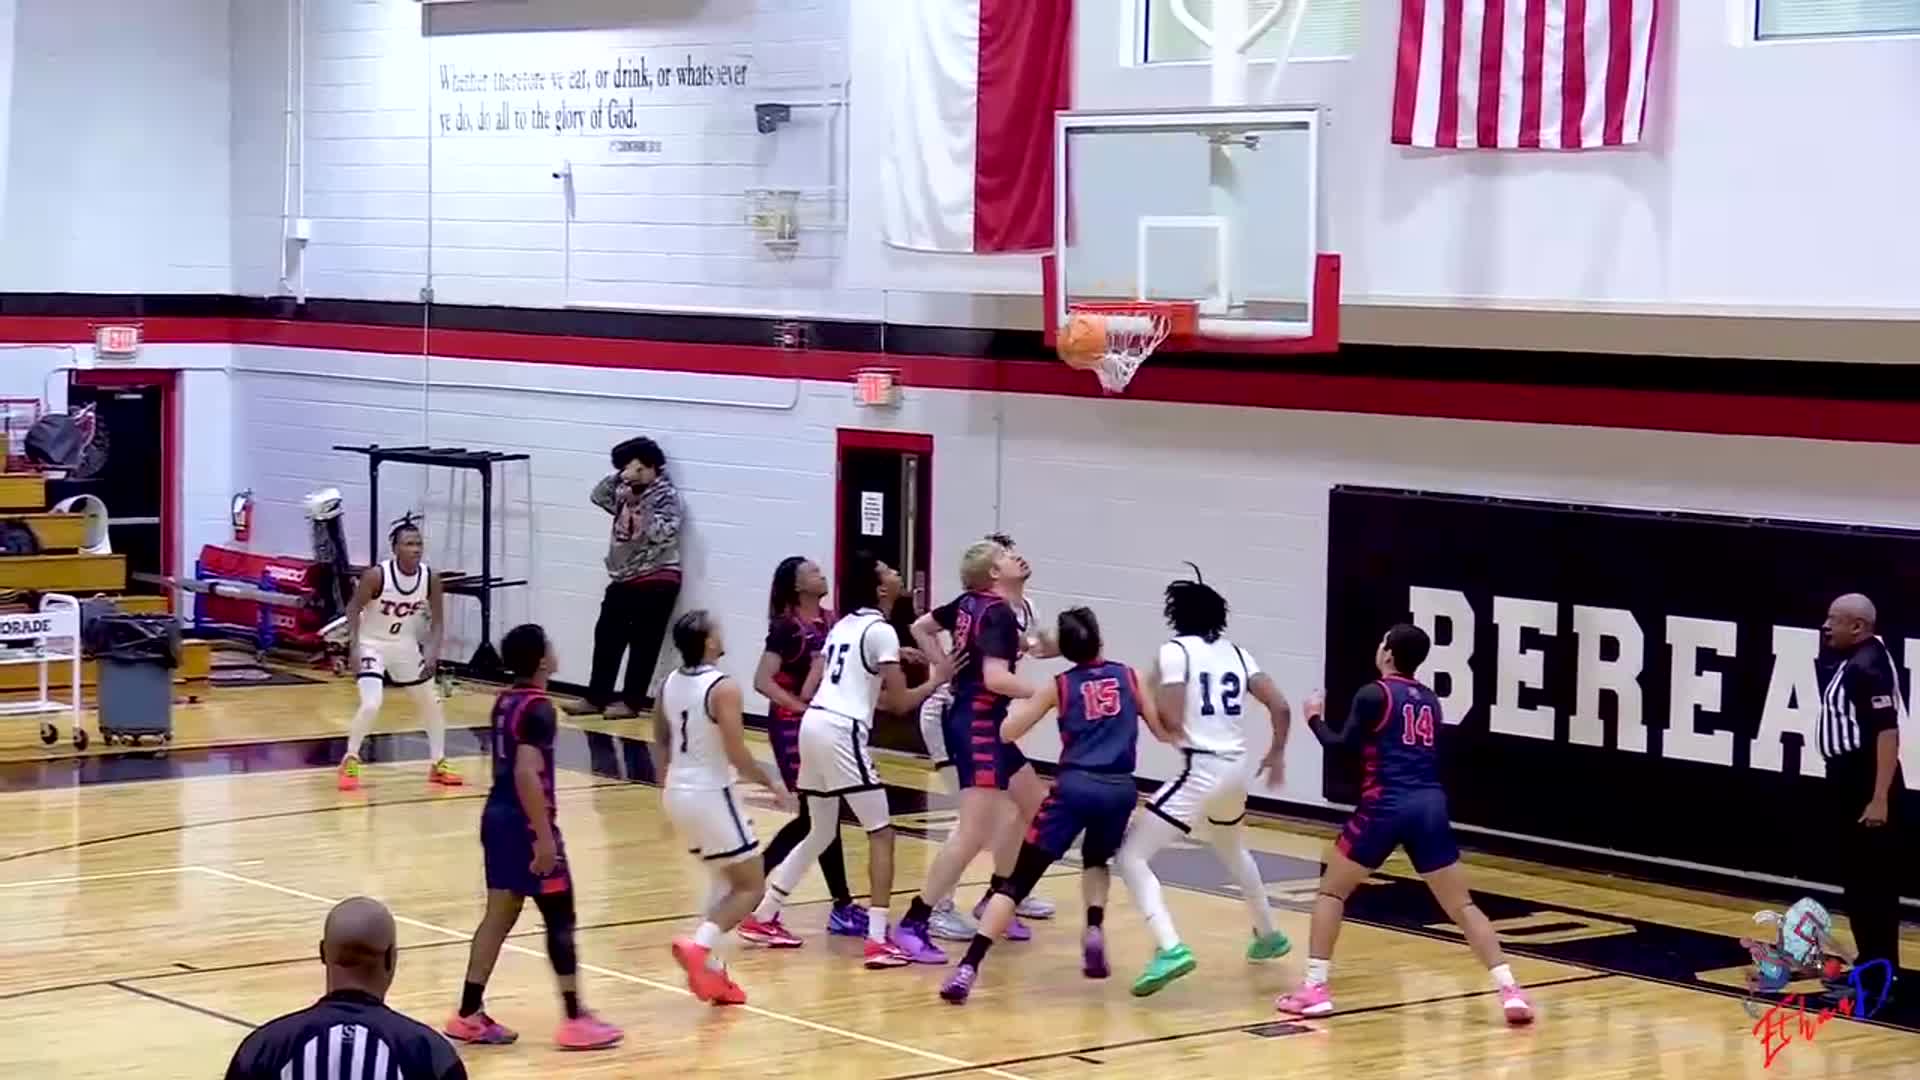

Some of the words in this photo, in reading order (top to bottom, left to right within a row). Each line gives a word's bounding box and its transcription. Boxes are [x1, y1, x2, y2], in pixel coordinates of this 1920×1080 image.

[596, 69, 609, 88] or
[614, 55, 654, 91] drink,
[657, 67, 672, 87] or
[496, 101, 509, 130] all
[515, 110, 527, 130] to
[532, 100, 550, 129] the
[555, 99, 585, 136] glory
[590, 97, 603, 129] of
[608, 96, 637, 129] God.
[389, 622, 402, 635] 0
[827, 642, 850, 685] 15
[1079, 677, 1122, 721] 15
[1200, 670, 1243, 717] 12
[680, 710, 689, 753] 1
[1402, 703, 1435, 747] 14
